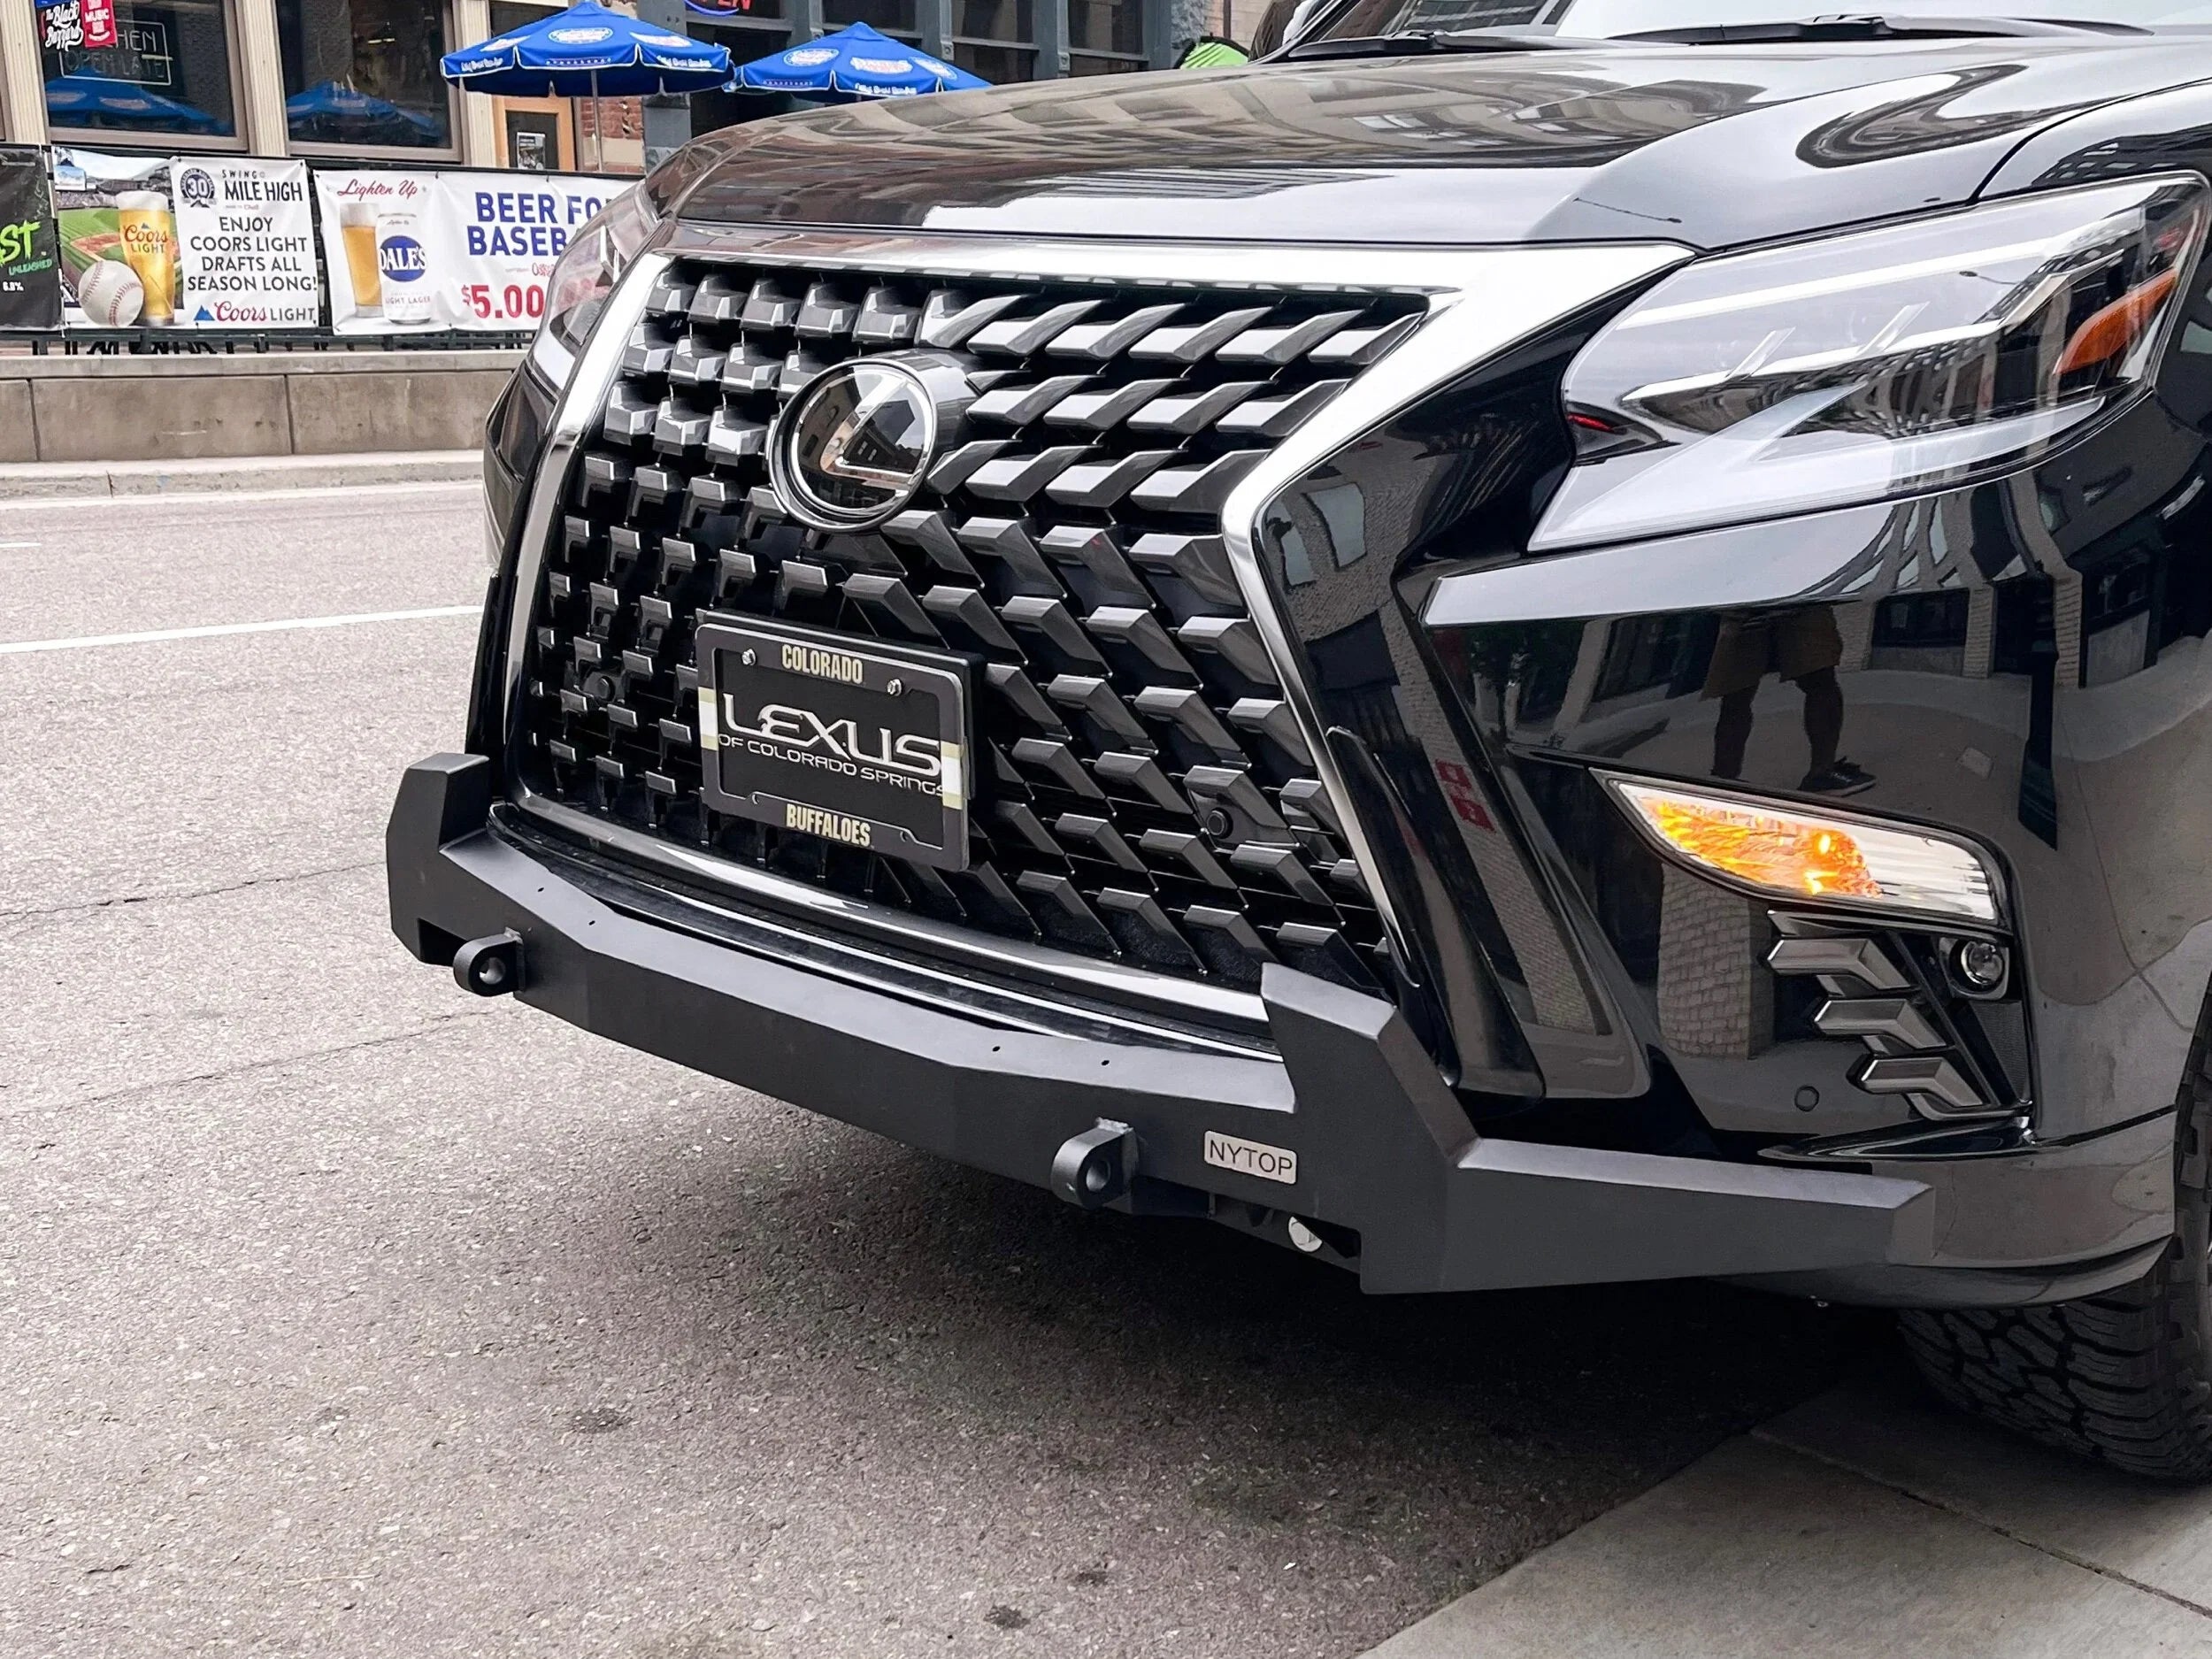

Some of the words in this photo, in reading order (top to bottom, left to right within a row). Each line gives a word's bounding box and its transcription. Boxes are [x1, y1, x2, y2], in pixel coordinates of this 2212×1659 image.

[116, 30, 156, 52] HEN
[222, 169, 257, 180] SWING
[186, 177, 209, 196] 30
[225, 180, 263, 201] MILE
[264, 181, 303, 202] HIGH
[337, 179, 394, 202] Lighten
[398, 179, 418, 200] Up
[475, 192, 558, 223] BEER
[566, 196, 612, 225] FO
[123, 224, 168, 242] Coors
[219, 217, 273, 233] ENJOY
[0, 220, 41, 266] ST
[130, 243, 165, 253] LIGHT
[190, 236, 252, 251] COORS
[257, 237, 307, 252] LIGHT
[466, 226, 567, 257] BASEB
[202, 257, 265, 272] DRAFTS
[271, 257, 302, 272] ALL
[380, 246, 427, 271] DALE'S
[188, 276, 257, 291] SEASON
[263, 276, 318, 291] LONG!
[214, 301, 266, 321] Coors
[270, 308, 315, 320] LIGHT
[461, 284, 544, 319] $5.00
[781, 644, 864, 685] COLORADO
[723, 693, 942, 777] LEXUS
[718, 733, 744, 749] OF
[747, 740, 857, 777] COLORADO
[786, 803, 871, 847] BUFFALOES
[1210, 1140, 1293, 1175] NYTOP
